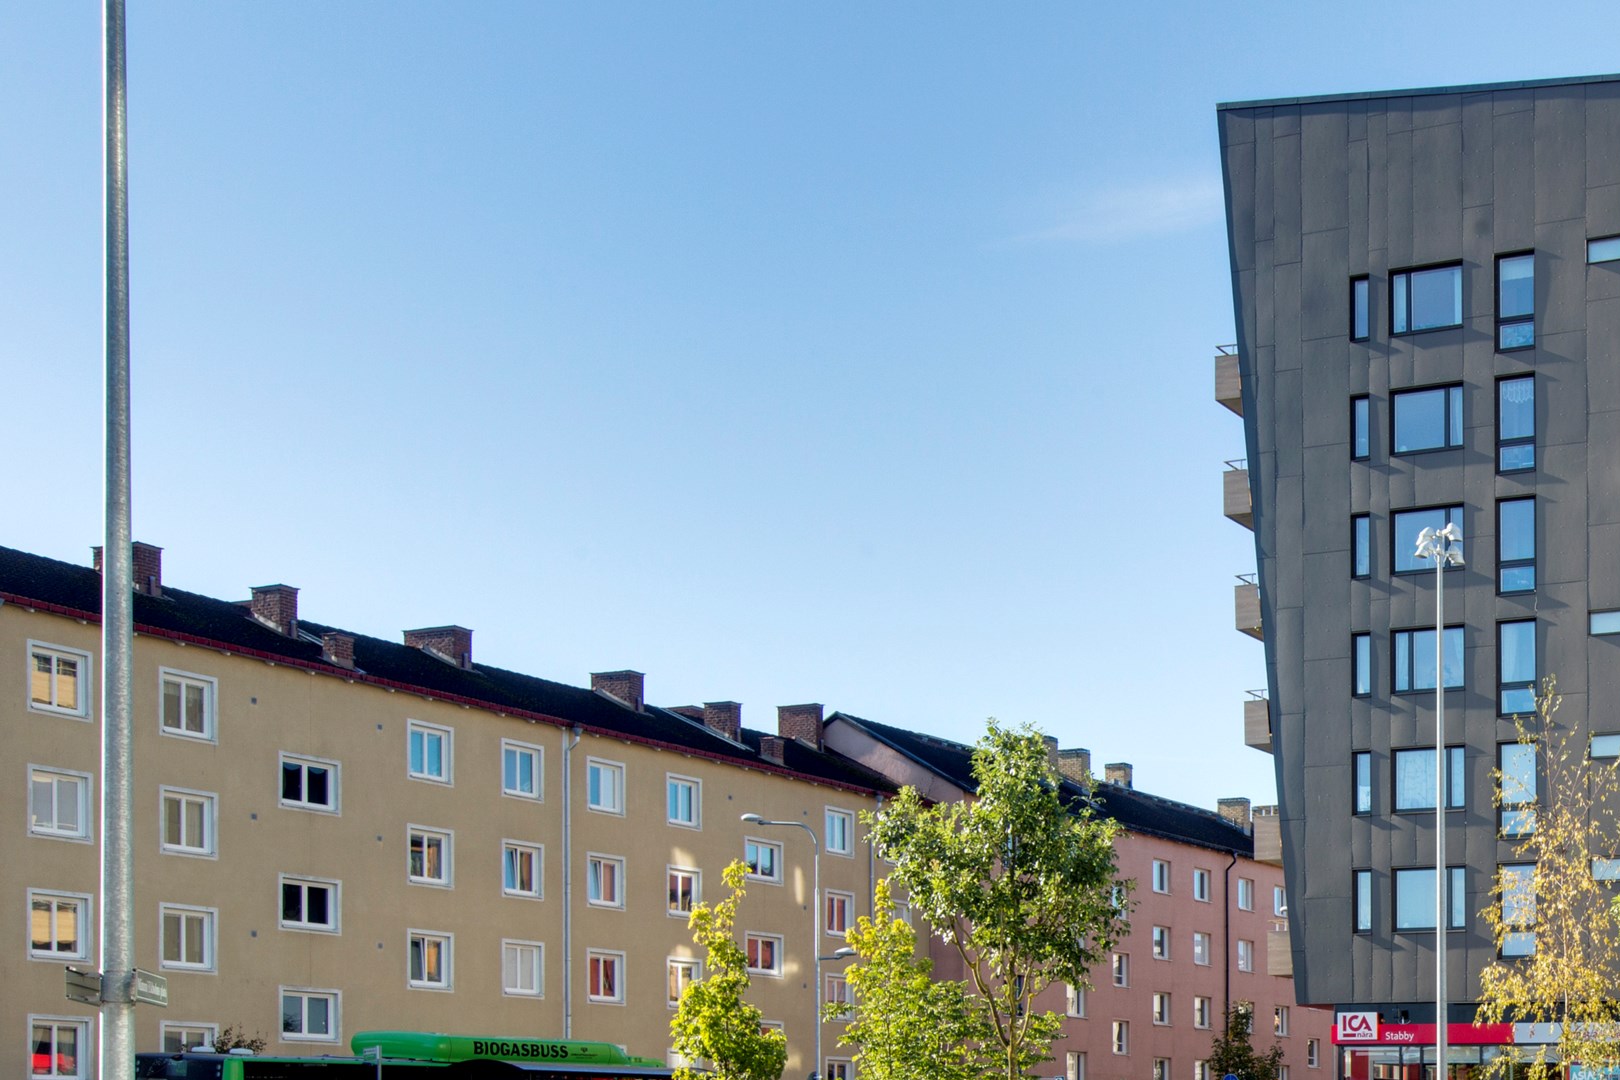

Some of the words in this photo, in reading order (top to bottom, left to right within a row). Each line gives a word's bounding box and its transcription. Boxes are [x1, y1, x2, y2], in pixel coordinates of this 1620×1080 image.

[1342, 1014, 1373, 1032] ICA
[1385, 1031, 1414, 1042] Stabby
[473, 1041, 569, 1059] BIOGASBUSS
